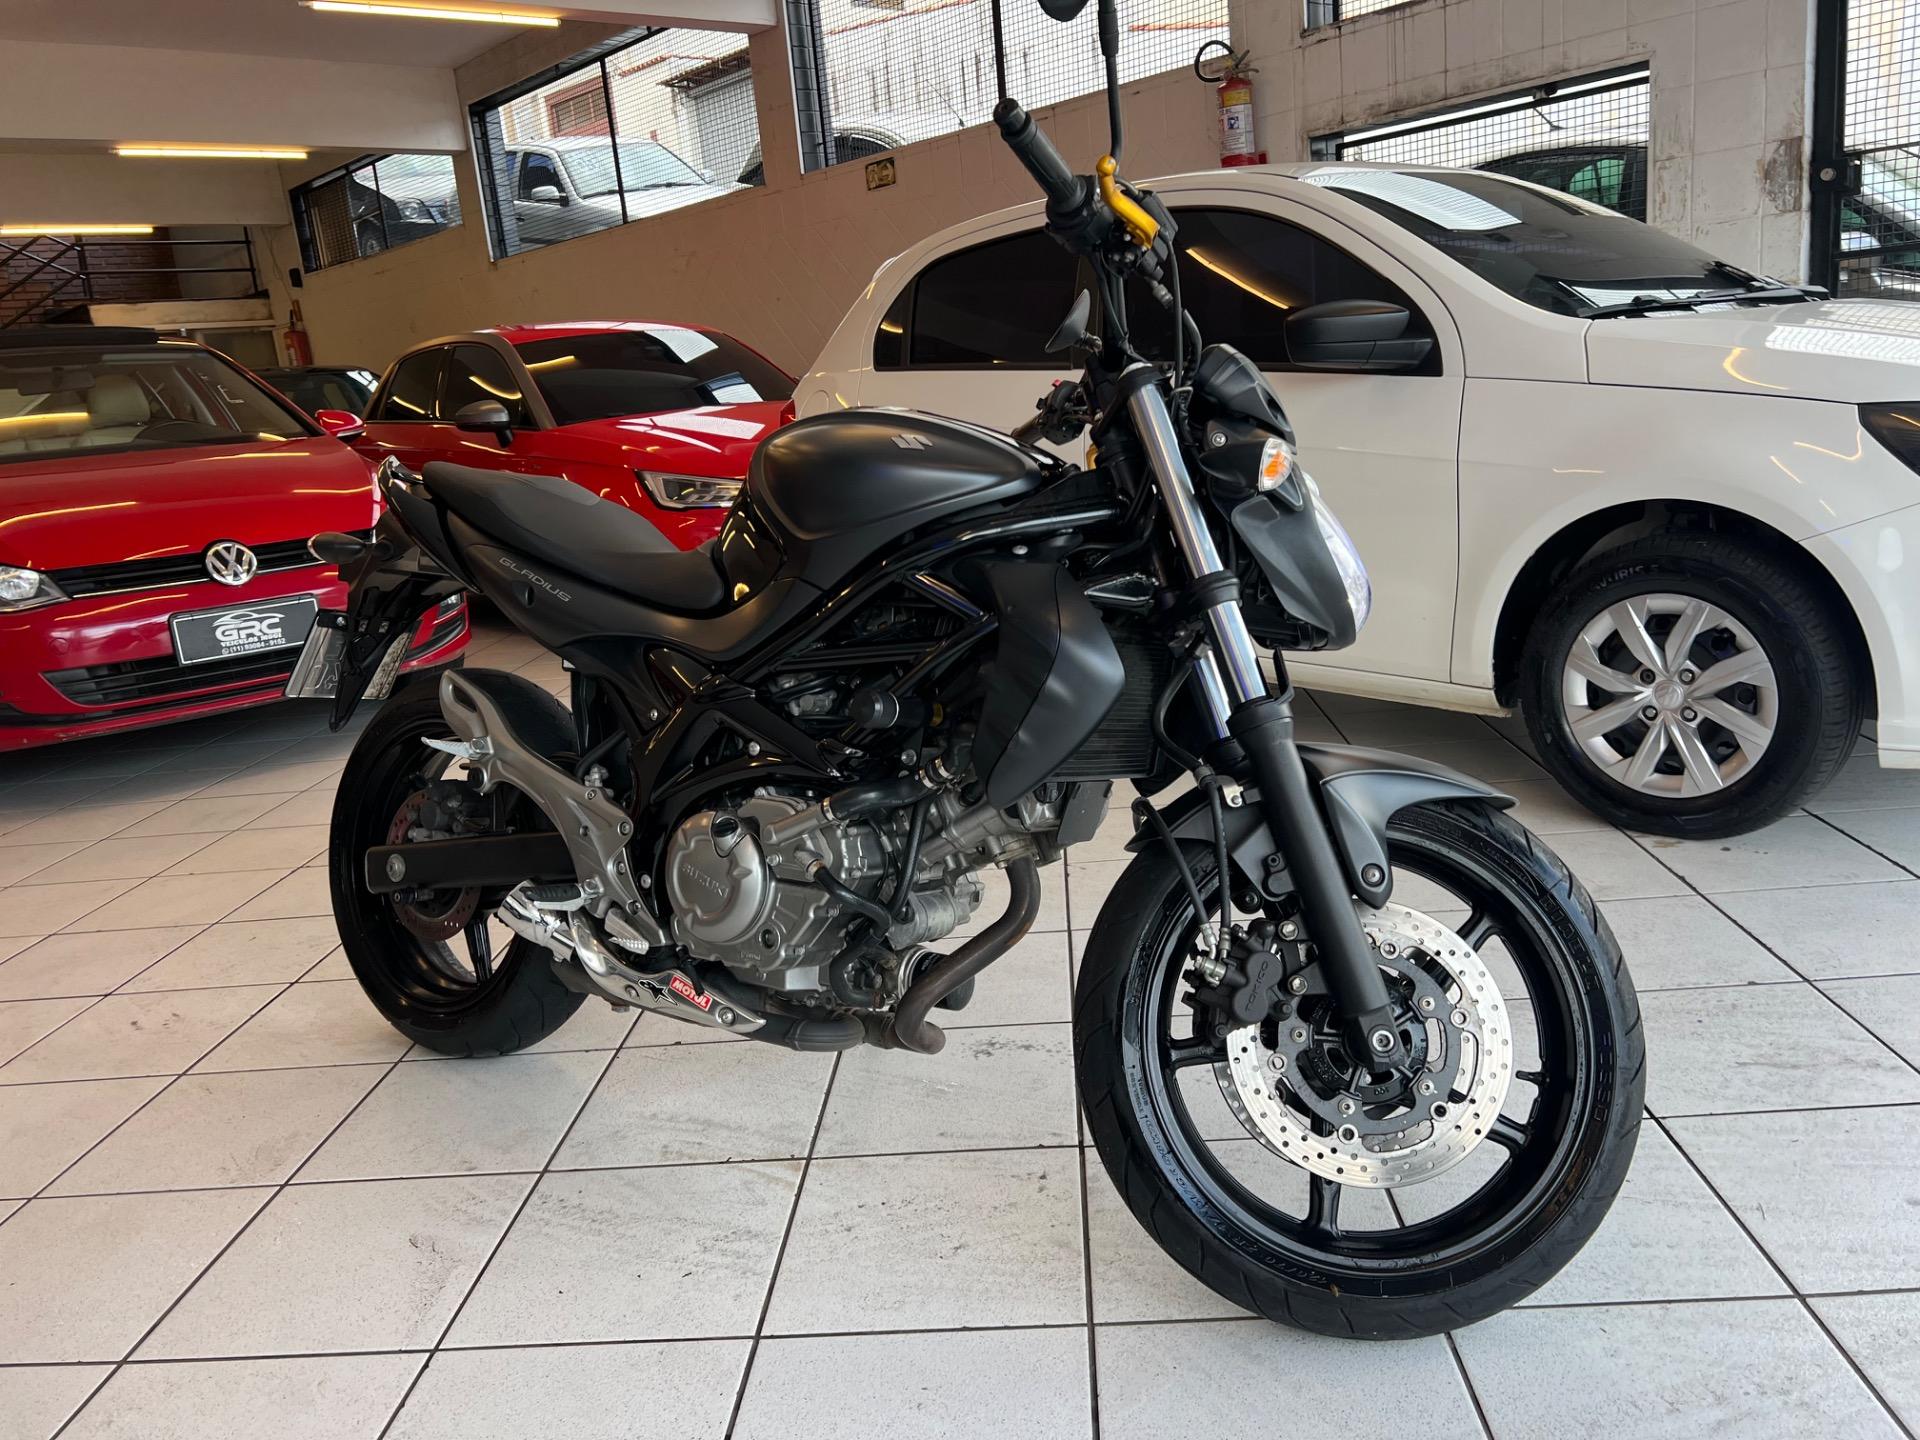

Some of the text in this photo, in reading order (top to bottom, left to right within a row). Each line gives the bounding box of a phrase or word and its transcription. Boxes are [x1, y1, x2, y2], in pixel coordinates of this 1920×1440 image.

[499, 557, 572, 602] GLADIUS
[215, 618, 282, 642] GRC
[671, 979, 708, 1007] MOTUL
